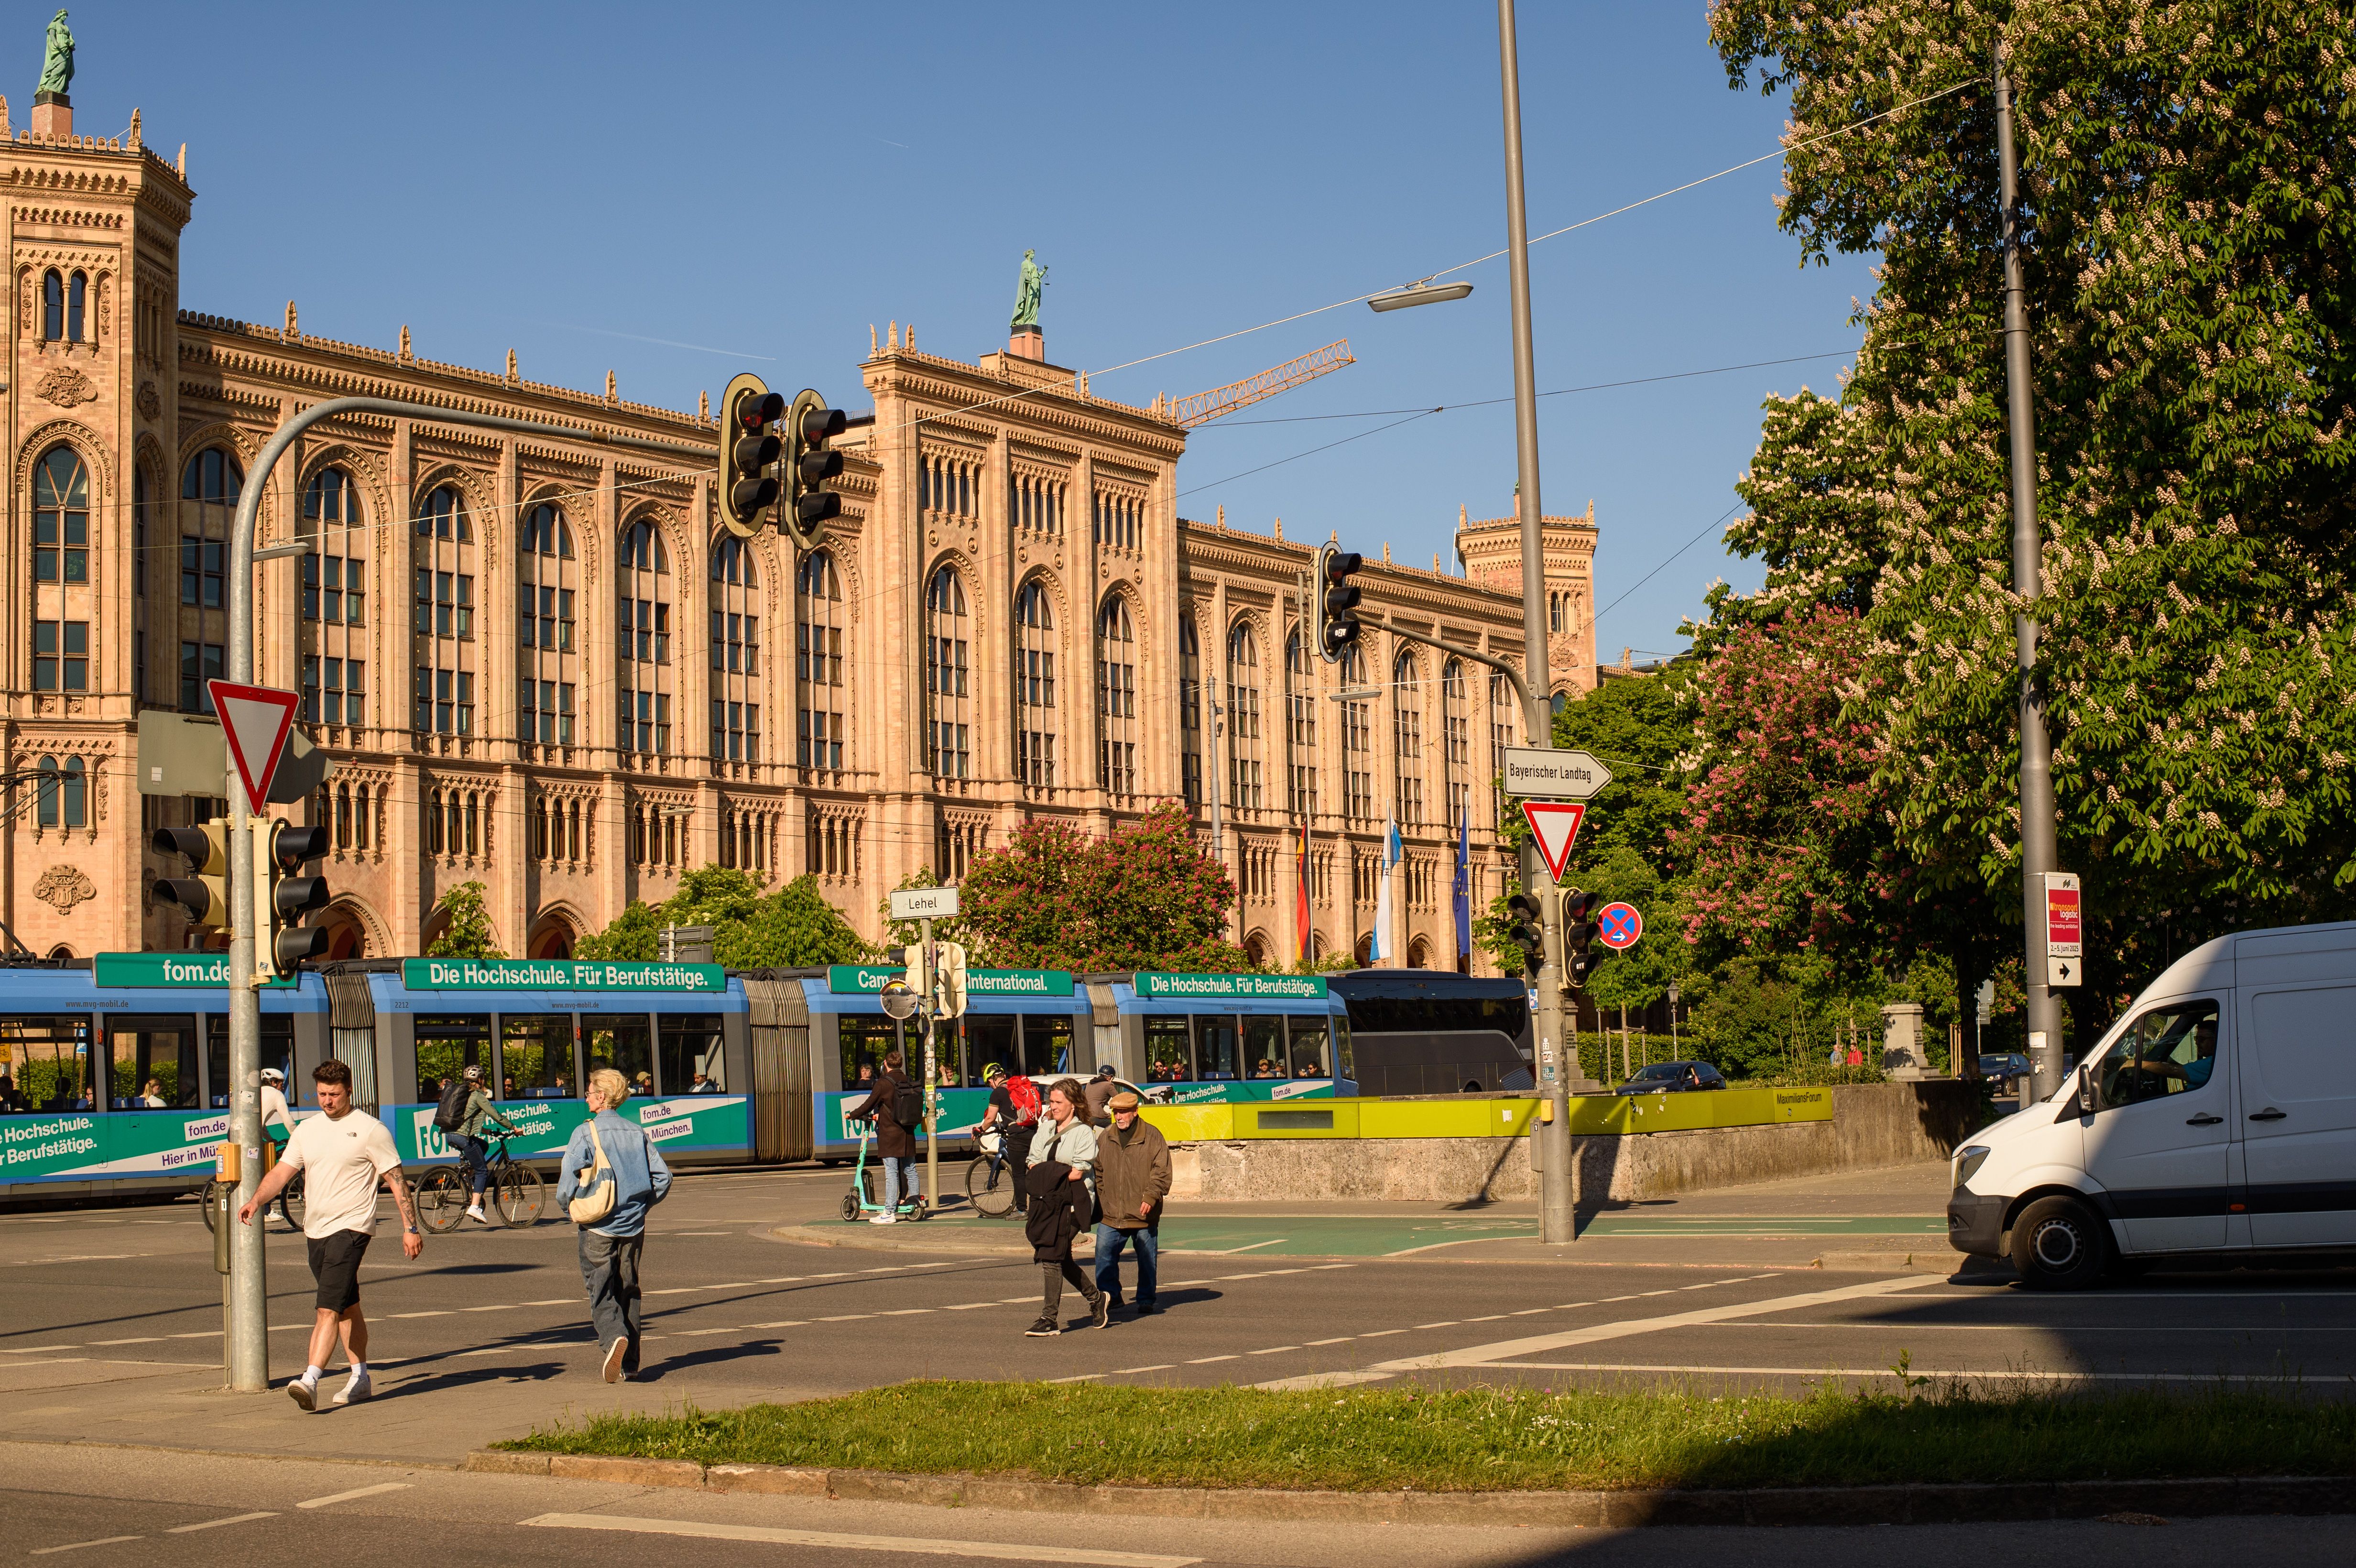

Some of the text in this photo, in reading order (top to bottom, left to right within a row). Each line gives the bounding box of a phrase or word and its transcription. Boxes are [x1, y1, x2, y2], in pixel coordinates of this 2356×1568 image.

[1510, 763, 1591, 784] Bayerischer Landtag
[908, 897, 937, 909] Lehel
[2054, 903, 2078, 912] transport
[2060, 910, 2078, 920] logistic
[430, 964, 708, 990] Die Hochschule. Für Berufstätige.
[968, 974, 1047, 991] International.
[1151, 976, 1318, 997] Die Hochschule. Für Berufstätige.
[65, 1000, 129, 1009] www.mvg-mobil.de
[1187, 1084, 1226, 1100] Hochschule.
[1274, 1087, 1291, 1097] fom.de
[1777, 1092, 1822, 1104] MaximiliansForum
[643, 1106, 671, 1120] fom.de
[5, 1117, 93, 1143] Hochschule.
[189, 1121, 226, 1136] fom.de
[652, 1124, 690, 1139] München.
[7, 1137, 97, 1165] Berufstätige.
[162, 1154, 184, 1166] Hier
[187, 1151, 197, 1161] in
